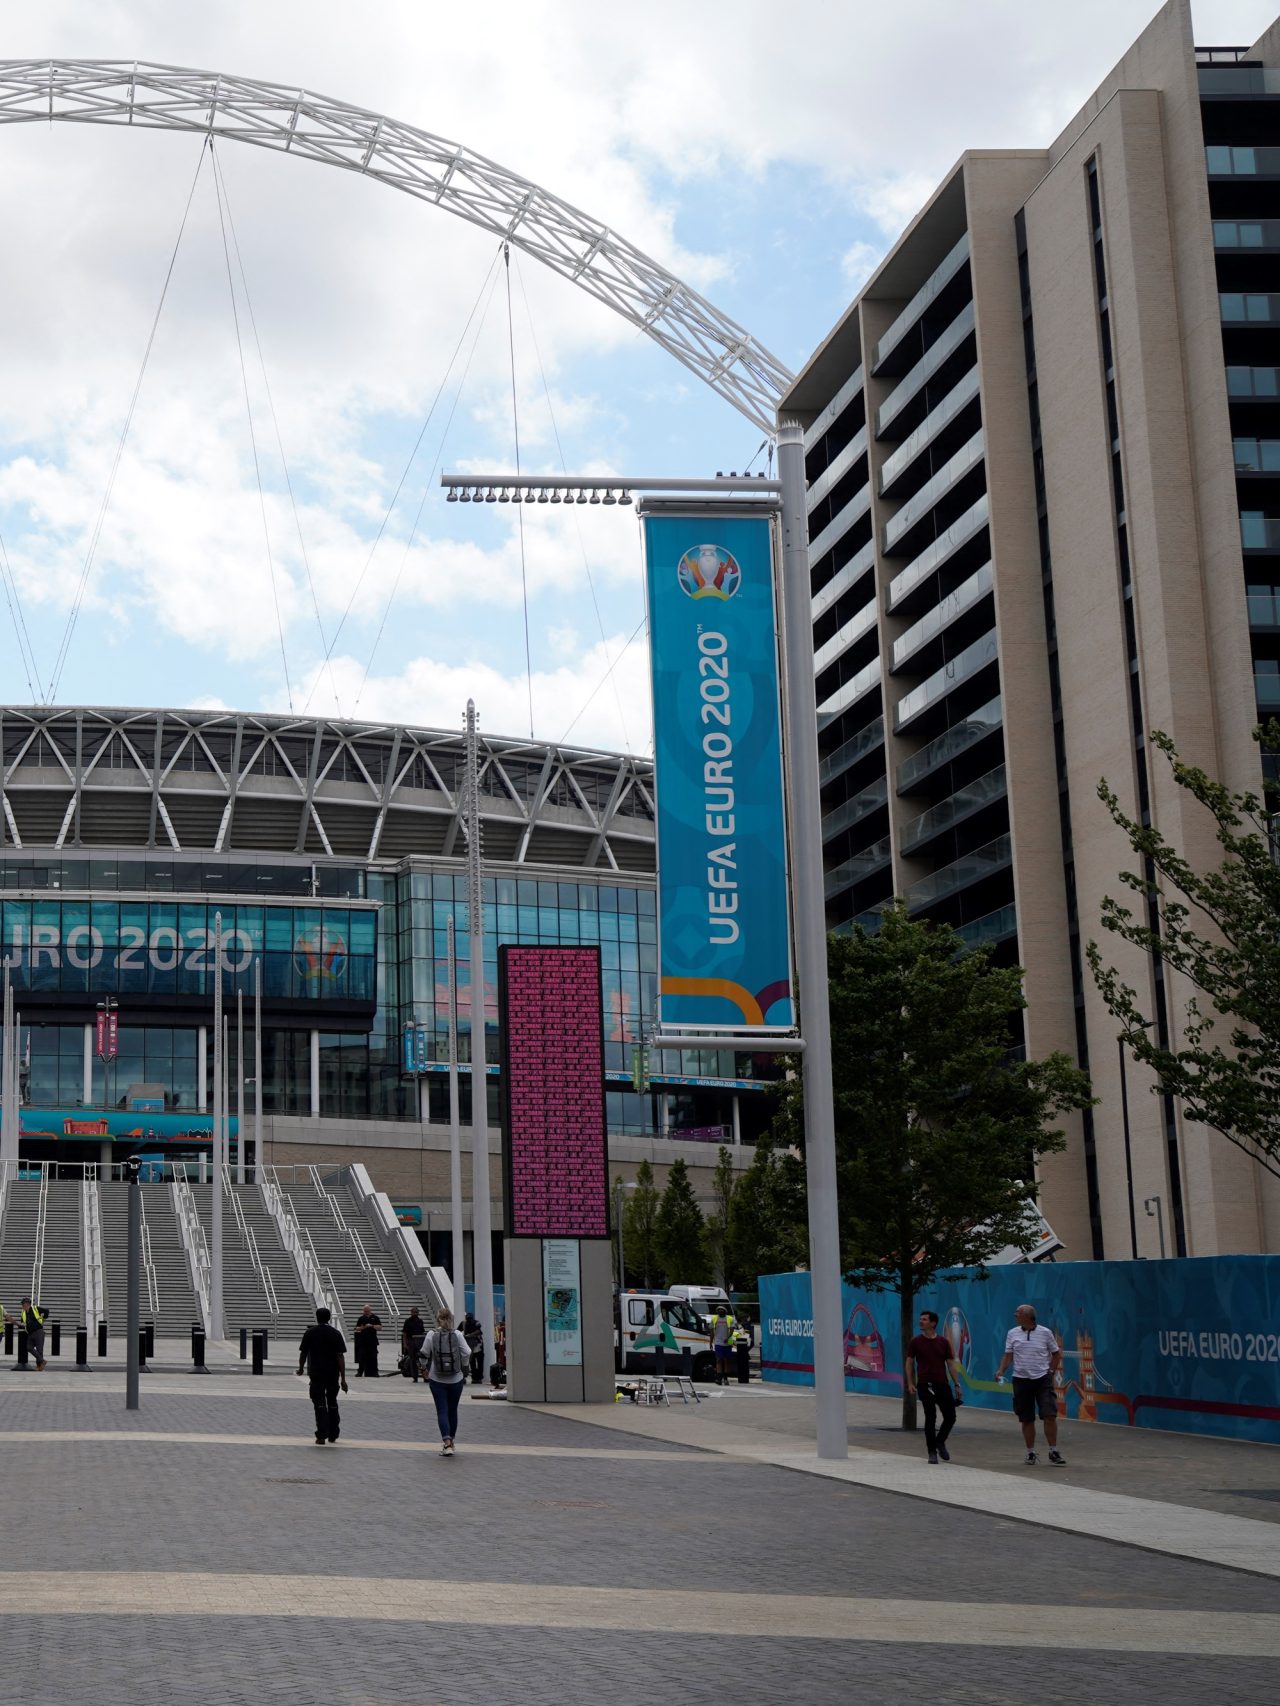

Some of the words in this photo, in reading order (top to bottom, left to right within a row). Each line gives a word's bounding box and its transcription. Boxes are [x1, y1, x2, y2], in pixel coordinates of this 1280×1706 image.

[702, 732, 734, 836] EURO
[708, 842, 739, 945] UEFA
[768, 1318, 785, 1336] UEFA
[785, 1319, 802, 1337] EURO
[802, 1320, 814, 1337] 202
[1159, 1330, 1198, 1358] UEFA
[1199, 1332, 1243, 1360] EURO
